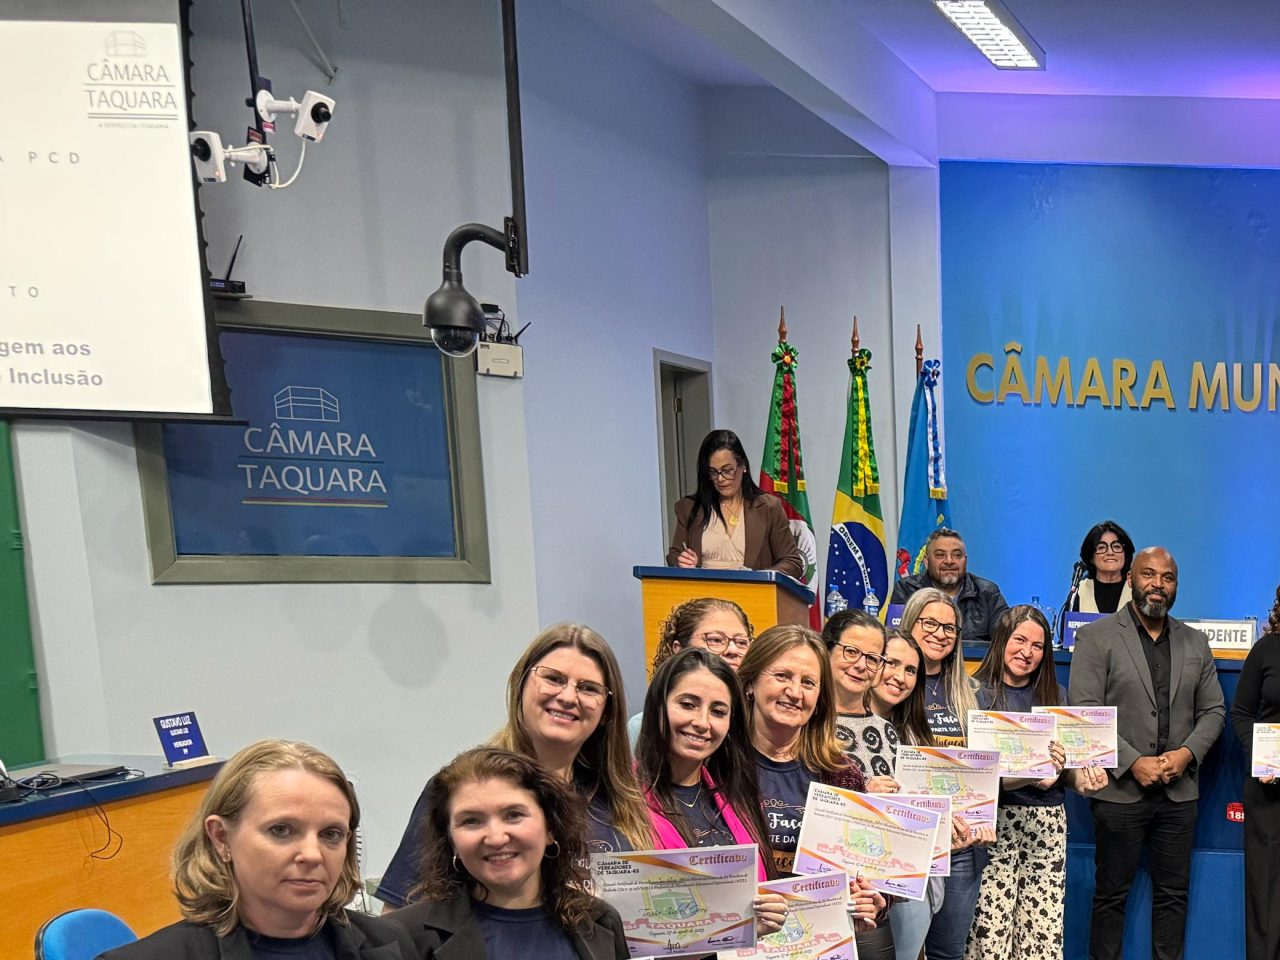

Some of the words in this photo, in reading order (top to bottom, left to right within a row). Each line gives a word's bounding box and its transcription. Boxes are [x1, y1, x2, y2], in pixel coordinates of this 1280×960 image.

[86, 58, 169, 82] CÂMARA
[84, 89, 177, 111] TAQUARA
[53, 342, 91, 357] aos
[9, 368, 103, 386] Inclusão
[965, 341, 1174, 410] CÂMARA
[244, 424, 376, 459] CÂMARA
[238, 464, 387, 495] TAQUARA
[838, 527, 860, 555] ORDEM
[783, 835, 796, 843] DA
[689, 853, 747, 866] Certificado
[792, 879, 840, 893] Certificado
